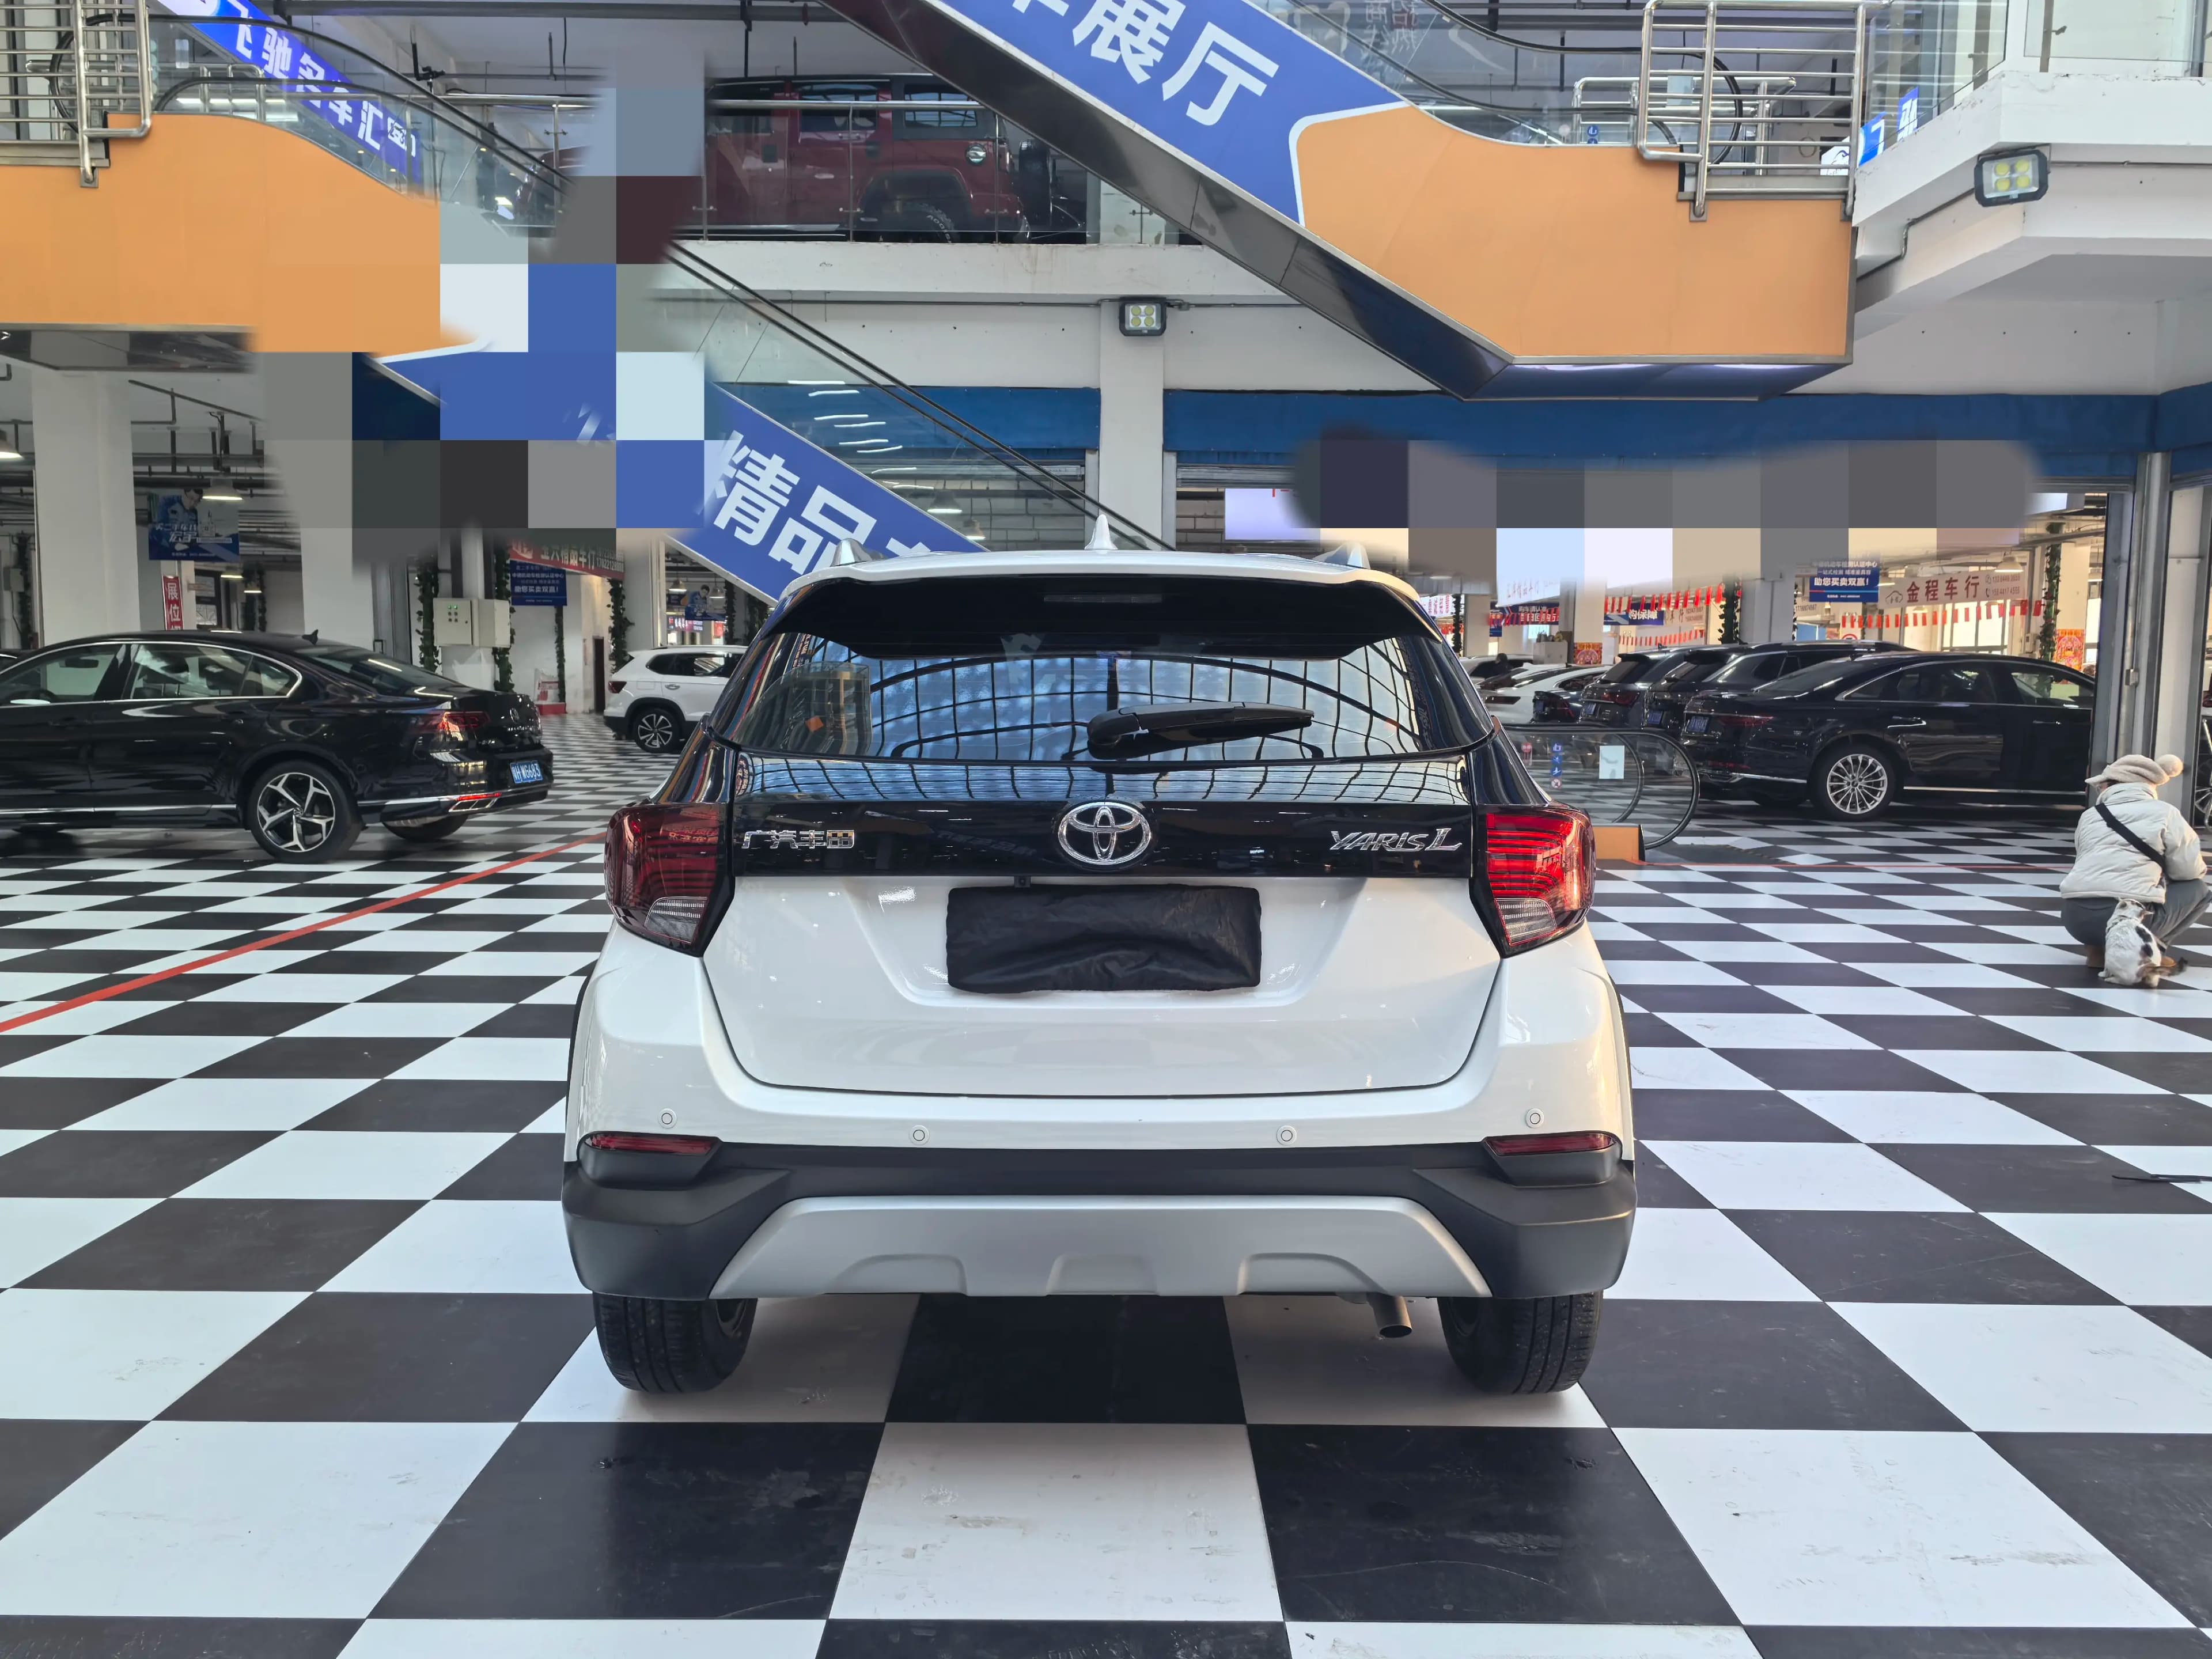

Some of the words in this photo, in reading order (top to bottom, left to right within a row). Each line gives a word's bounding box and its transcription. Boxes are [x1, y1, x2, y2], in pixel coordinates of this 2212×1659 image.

[1012, 0, 1279, 126] 展厅
[710, 430, 932, 575] 精品
[168, 582, 181, 630] 展位
[1907, 575, 1980, 603] 金程车行
[741, 830, 855, 849] 广汽丰田
